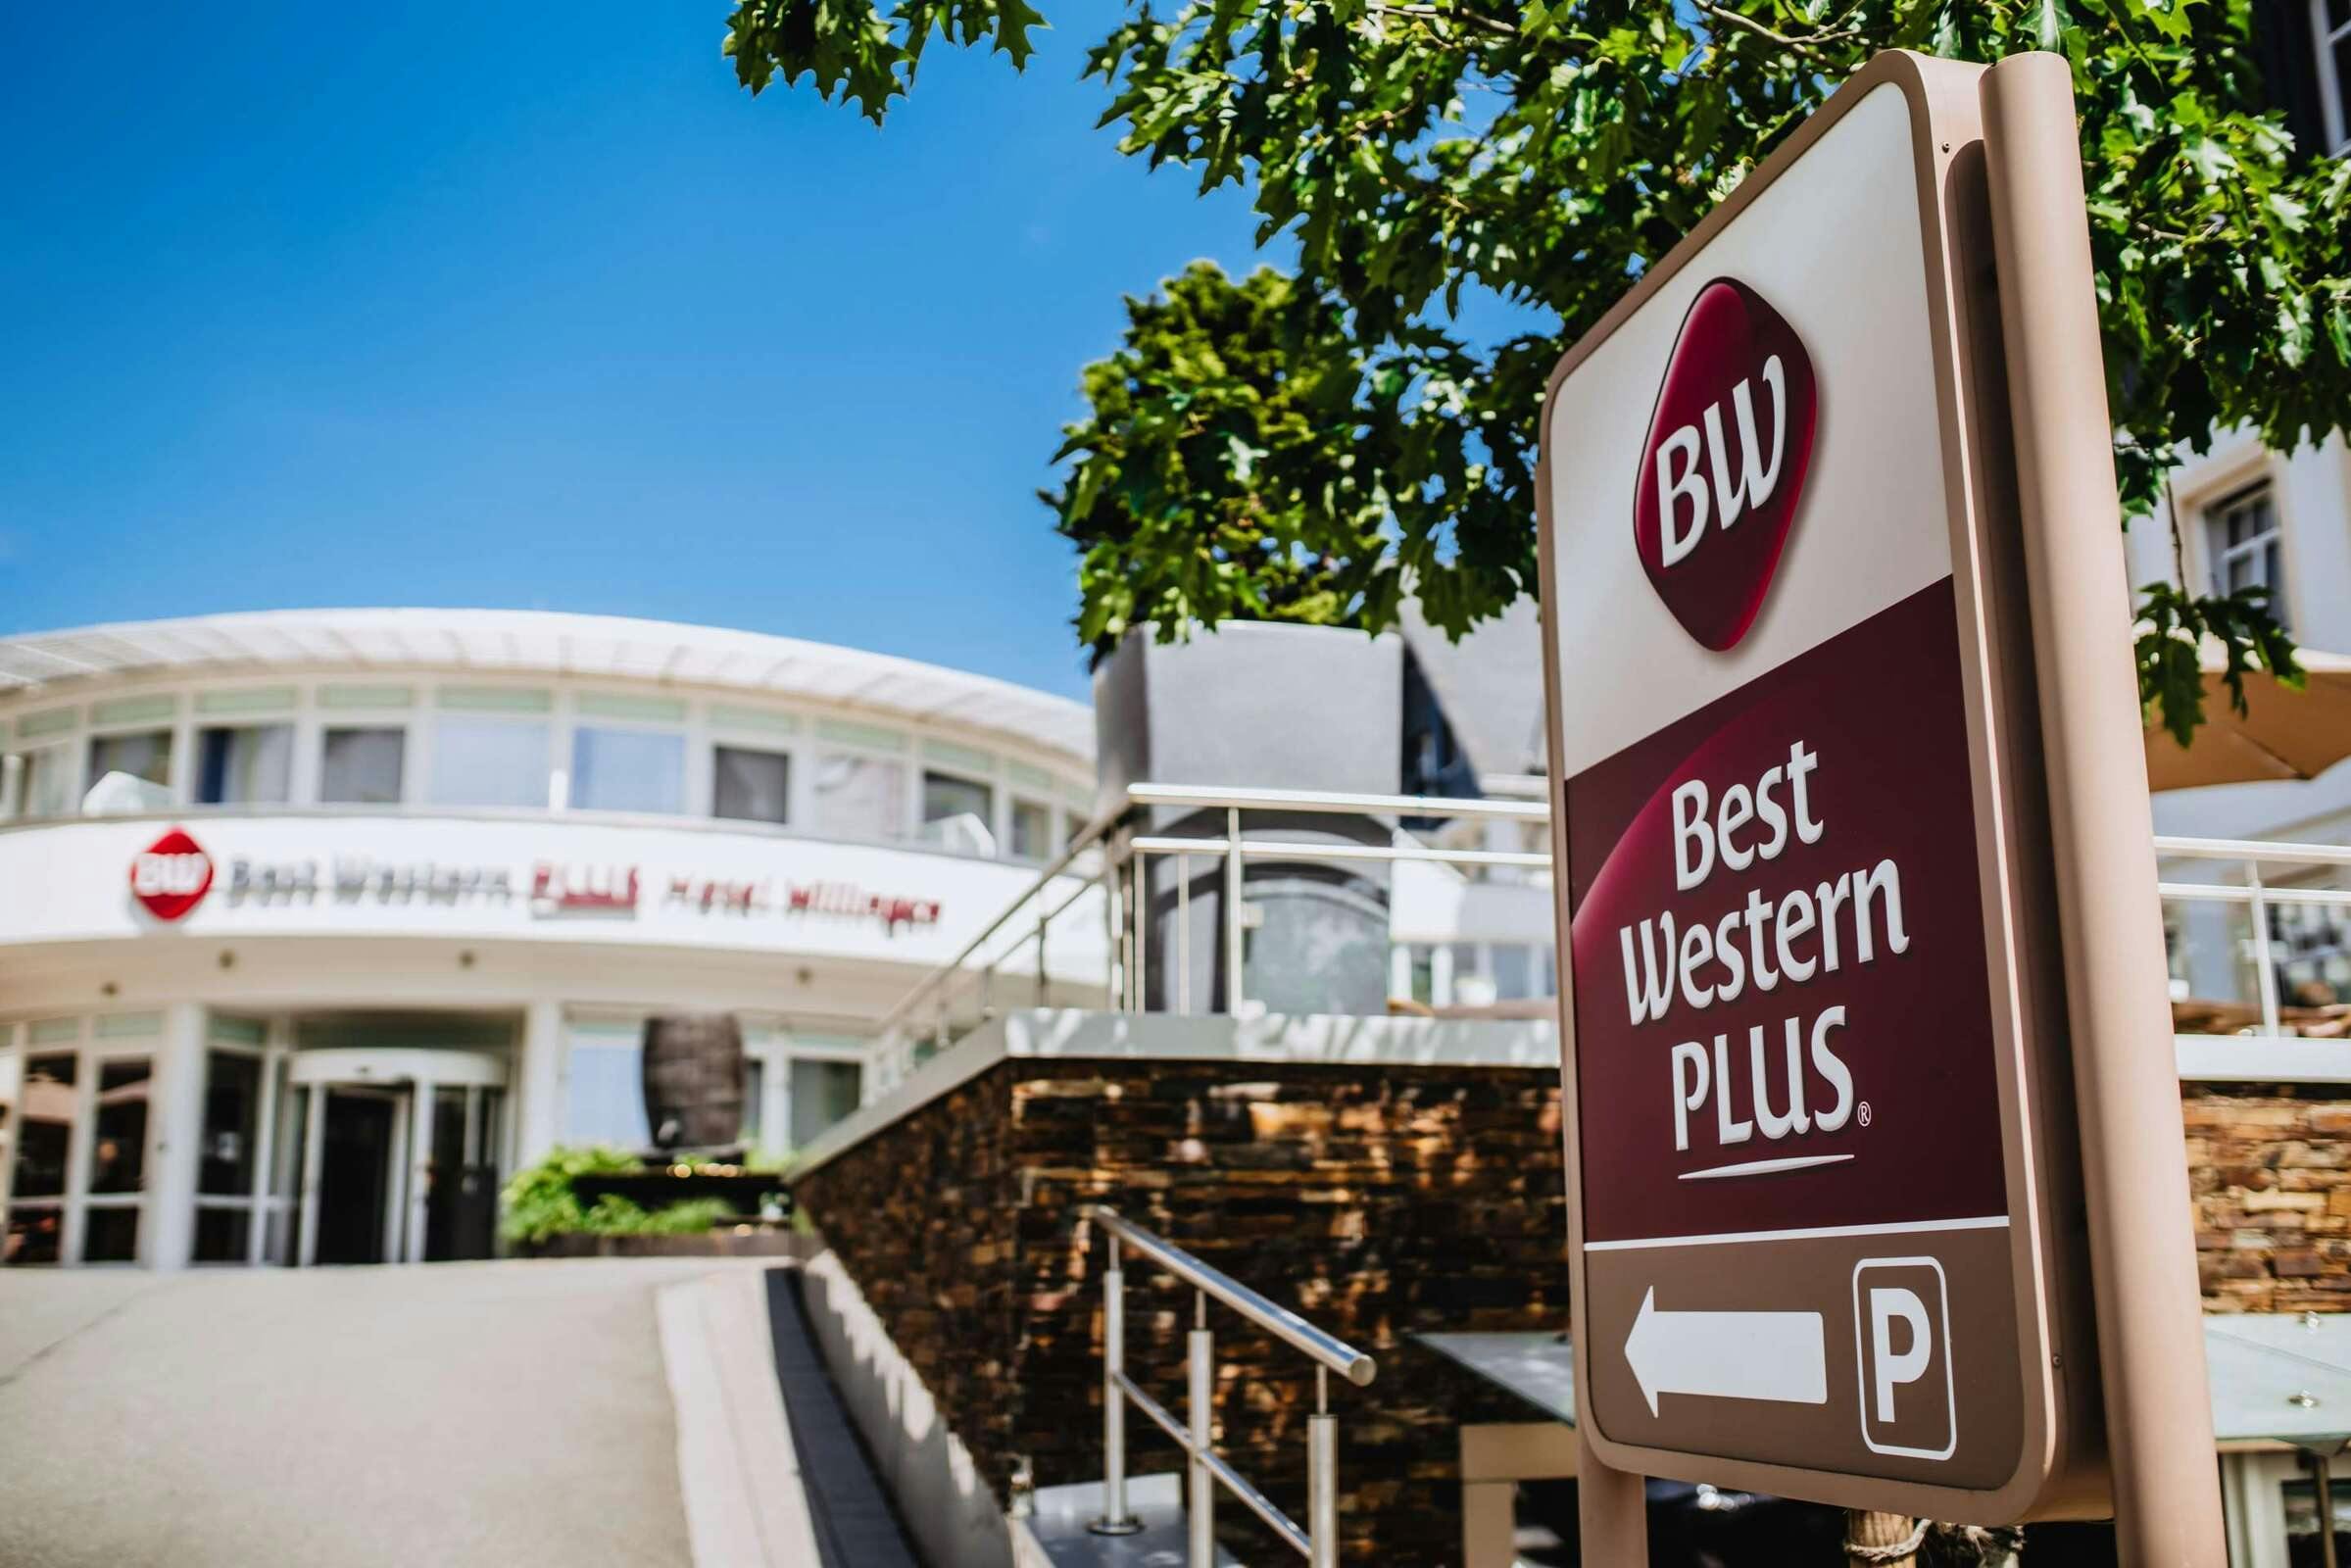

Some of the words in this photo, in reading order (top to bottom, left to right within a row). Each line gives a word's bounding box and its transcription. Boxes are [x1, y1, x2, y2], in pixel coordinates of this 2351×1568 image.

[1656, 354, 1787, 568] BW
[133, 852, 211, 898] BW
[1672, 740, 1825, 892] Best
[1619, 858, 1910, 1027] Western
[1870, 1288, 1933, 1423] P
